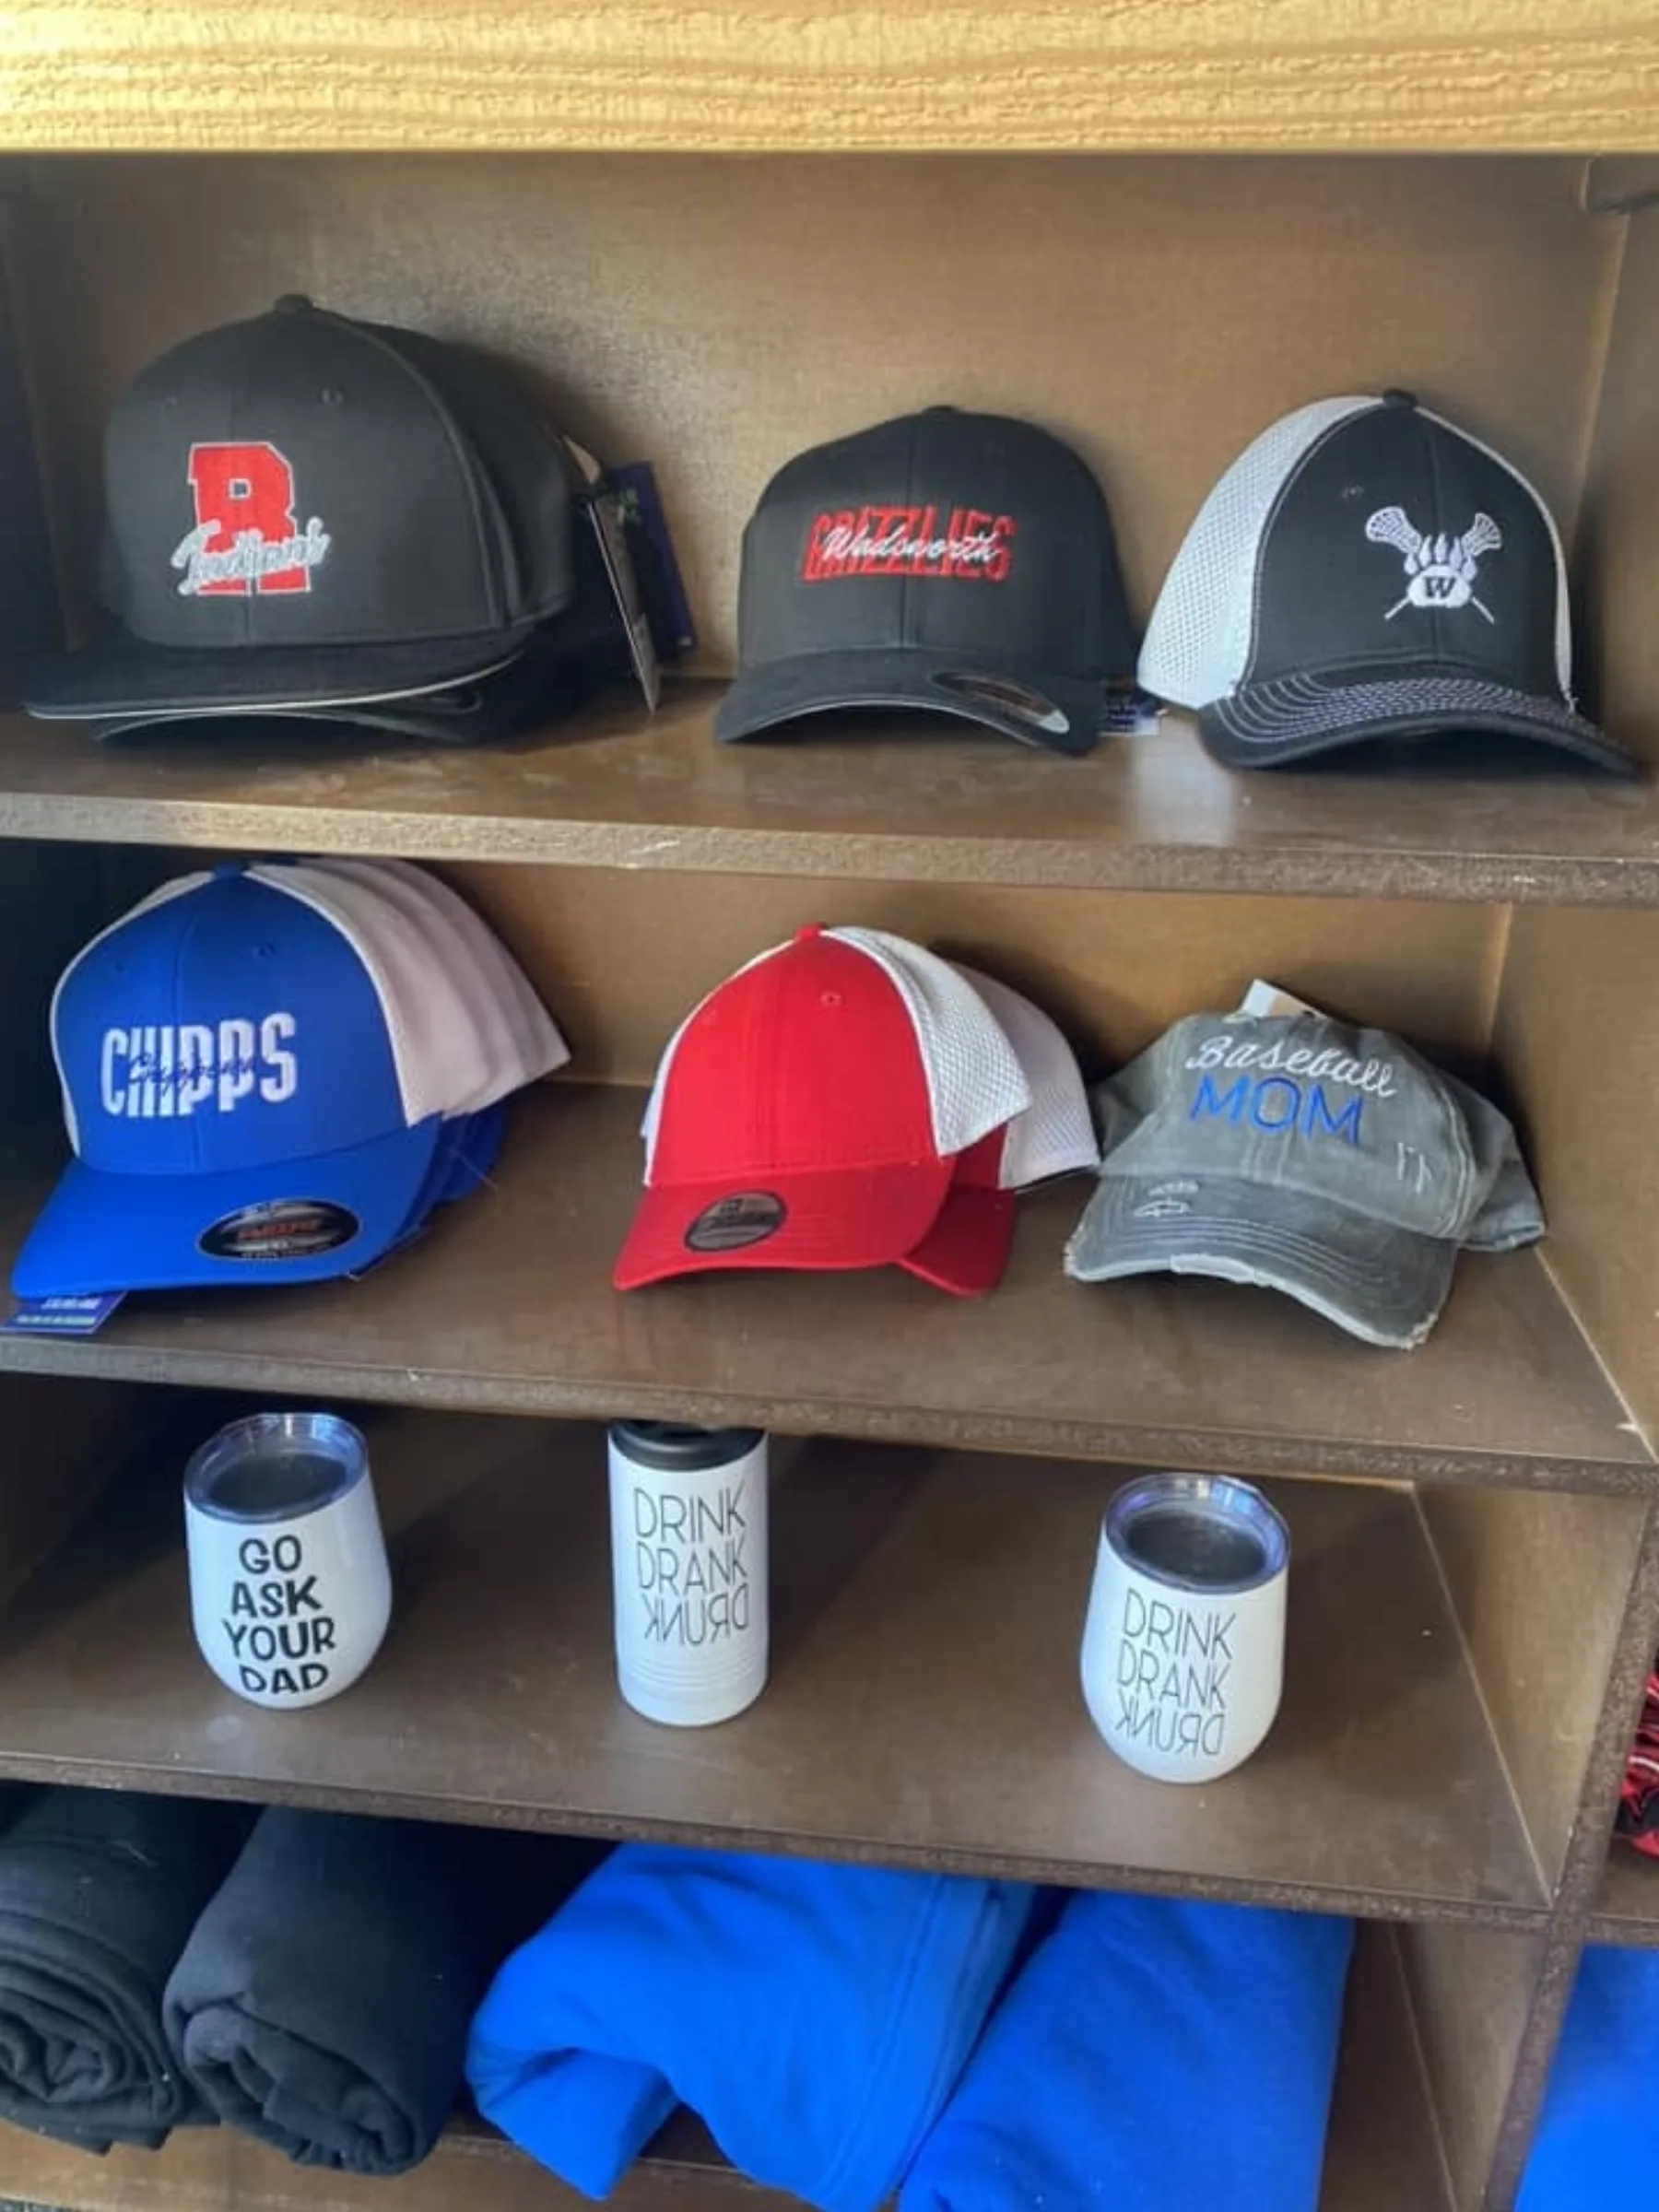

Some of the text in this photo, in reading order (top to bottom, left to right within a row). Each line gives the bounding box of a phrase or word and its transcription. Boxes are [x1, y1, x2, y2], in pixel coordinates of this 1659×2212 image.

[820, 523, 1003, 561] Wadsworth
[1423, 576, 1456, 598] W
[100, 1012, 298, 1118] CHIPPS
[1184, 1035, 1397, 1097] Baseball
[1189, 1073, 1363, 1145] MOM
[633, 1478, 747, 1544] DRINK
[239, 1535, 302, 1574] GO
[636, 1531, 748, 1596] DRANK
[231, 1575, 324, 1618] ASK
[1124, 1587, 1237, 1660] DRINK
[221, 1617, 336, 1660] YOUR
[240, 1663, 329, 1694] DAD
[1117, 1638, 1231, 1709] DRANK
